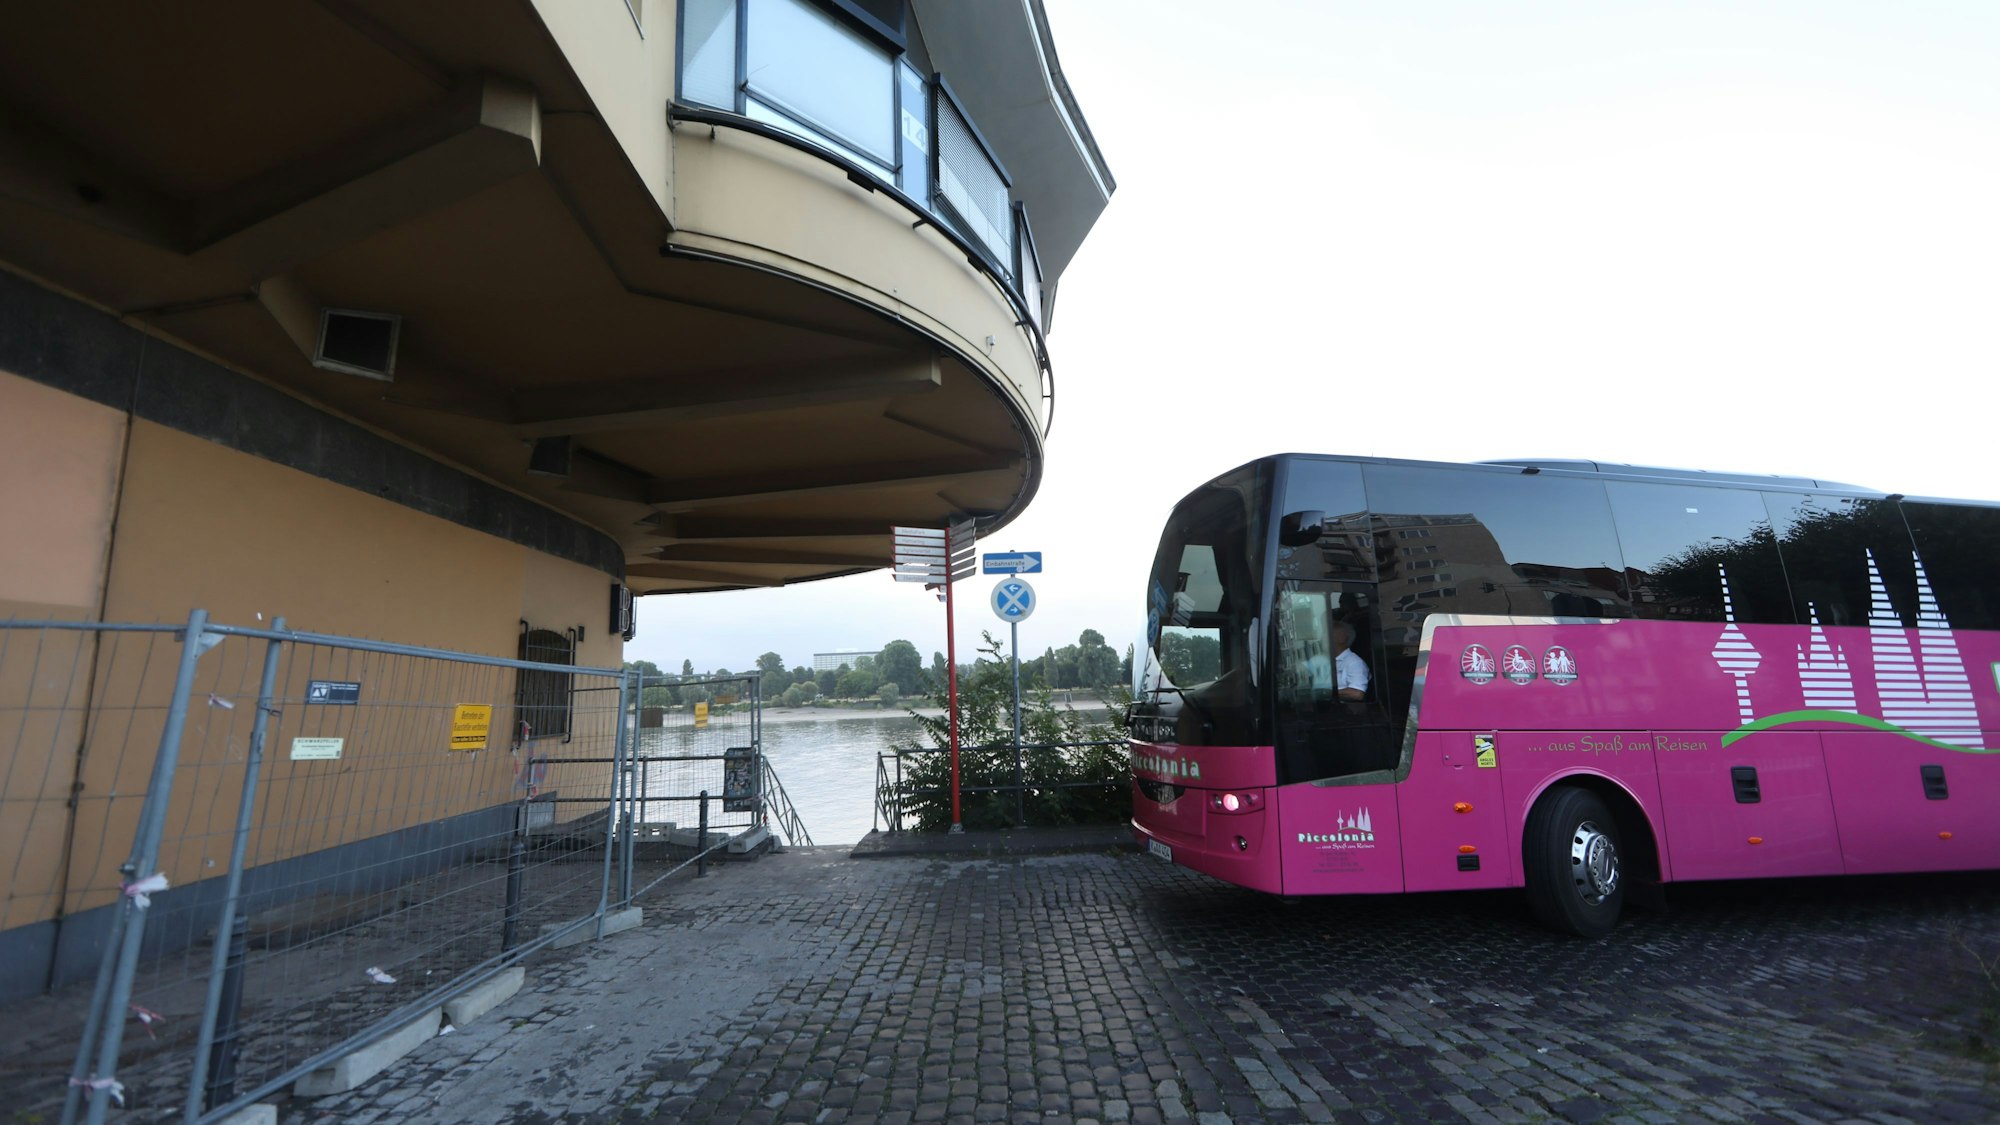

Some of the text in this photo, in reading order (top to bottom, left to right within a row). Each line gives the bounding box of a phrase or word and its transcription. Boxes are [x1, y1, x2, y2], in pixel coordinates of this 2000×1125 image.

[1548, 742, 1576, 752] aus
[1581, 735, 1624, 757] Spaß
[1628, 742, 1651, 751] am
[1655, 735, 1708, 752] Reisen
[1298, 832, 1375, 842] Piccolonia
